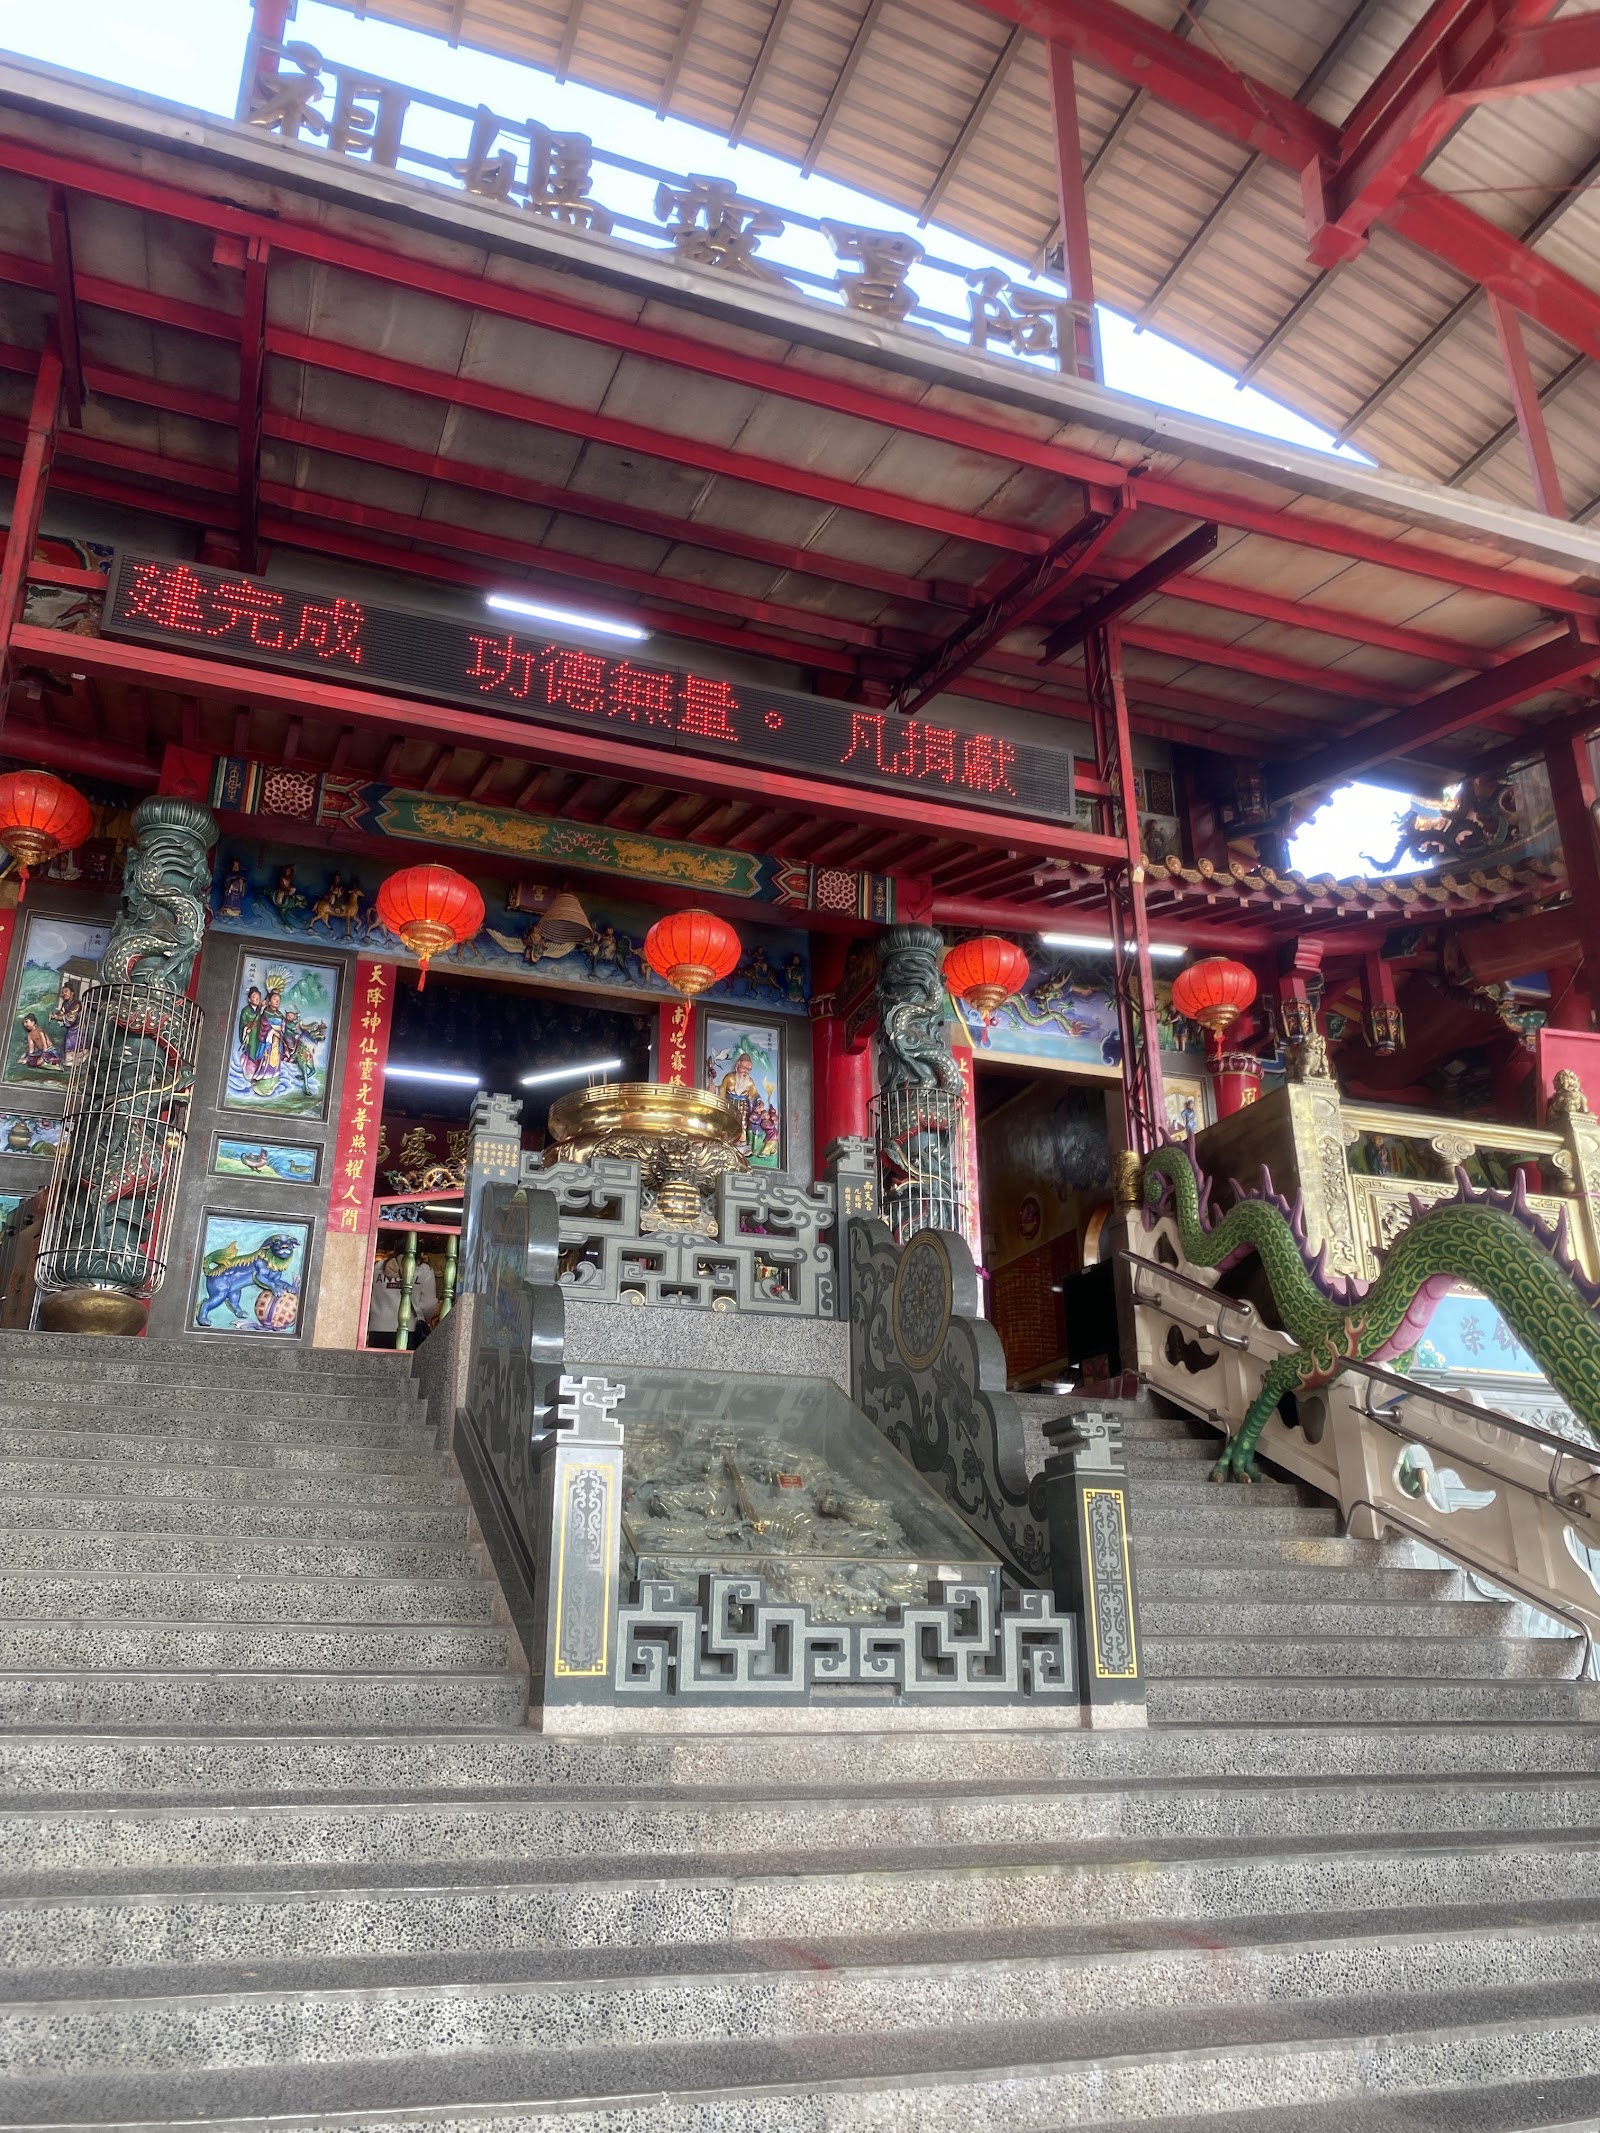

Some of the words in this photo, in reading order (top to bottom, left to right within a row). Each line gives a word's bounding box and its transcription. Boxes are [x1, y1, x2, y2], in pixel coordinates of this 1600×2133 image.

[124, 564, 364, 664] 建完成
[841, 714, 1016, 796] 凡捐獻
[341, 965, 387, 1233] 天降神仙靈光普照耀人間
[863, 1180, 874, 1212] 南天宮
